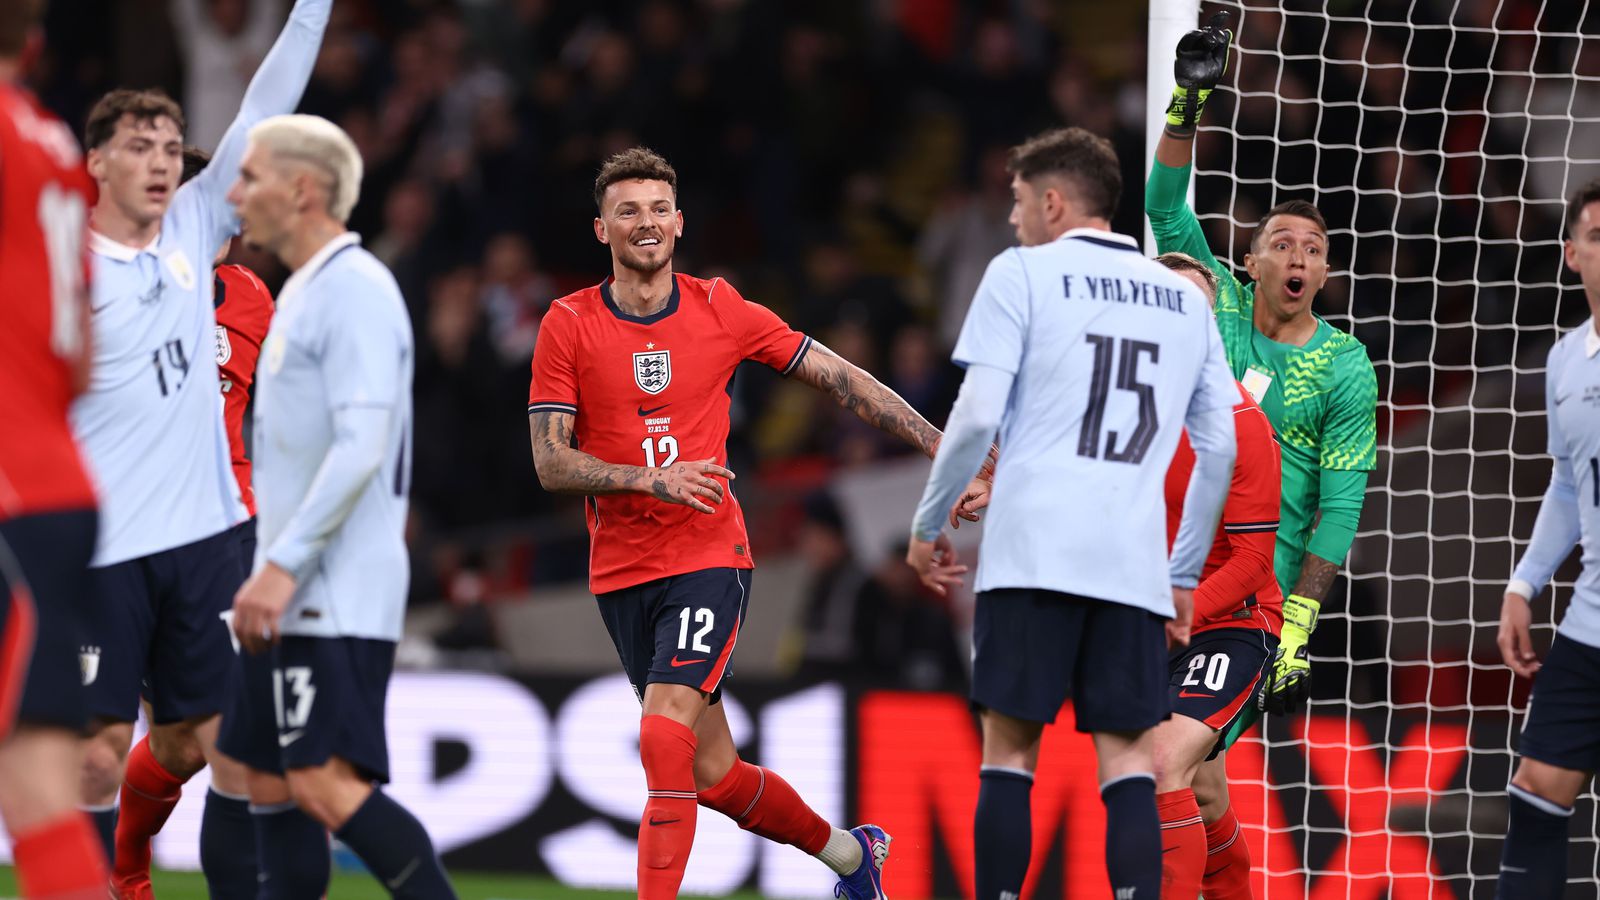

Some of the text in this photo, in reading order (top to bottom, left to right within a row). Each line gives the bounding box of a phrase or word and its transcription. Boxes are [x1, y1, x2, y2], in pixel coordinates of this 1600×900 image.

[152, 338, 189, 397] 19
[644, 417, 671, 426] URUGUAY
[1076, 333, 1160, 465] 15
[641, 434, 679, 468] 12
[677, 606, 715, 653] 12
[1181, 652, 1231, 691] 20
[272, 666, 316, 728] 13
